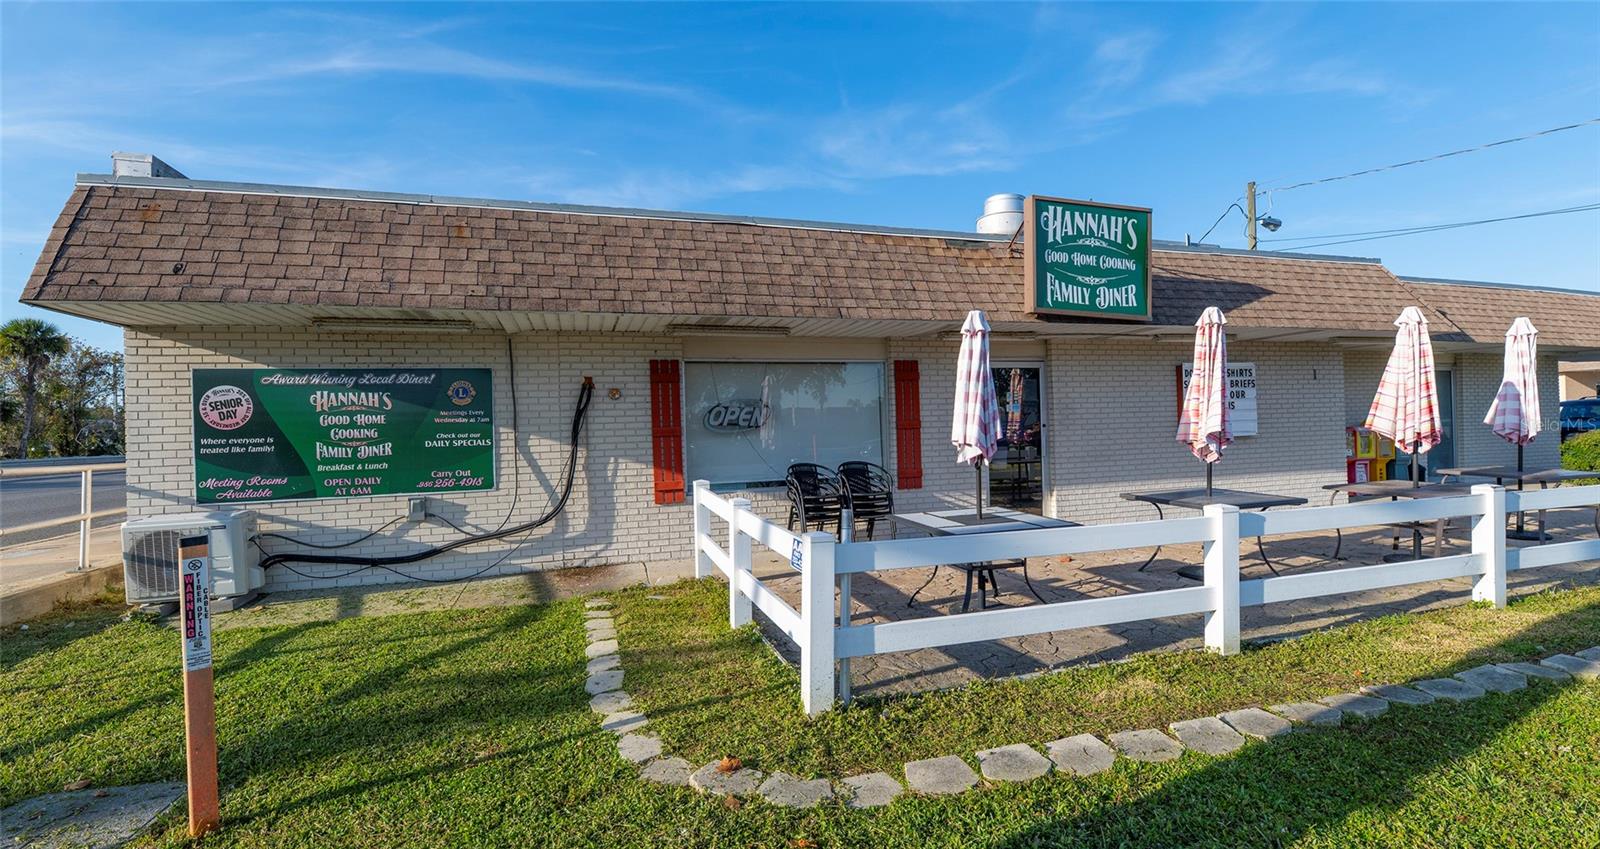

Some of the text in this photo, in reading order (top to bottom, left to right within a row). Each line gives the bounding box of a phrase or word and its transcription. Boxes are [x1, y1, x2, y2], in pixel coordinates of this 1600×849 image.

[1040, 206, 1138, 250] HANNAH'S
[1045, 249, 1136, 271] GOOD HOME COOKING
[1047, 272, 1137, 309] FAMILY DINER
[262, 372, 435, 387] Award Winning Local Diner!
[1227, 369, 1252, 377] SHIRTS
[1230, 380, 1255, 388] BRIEFS
[458, 388, 466, 397] L
[1230, 390, 1246, 399] OUR
[209, 397, 243, 412] SENIOR
[310, 391, 392, 412] HANNAH'S
[218, 409, 237, 421] DAY
[319, 414, 386, 426] GOOD HOME
[710, 406, 762, 427] OPEN
[330, 428, 378, 440] COOKING
[316, 441, 392, 461] FAMILY DINER
[317, 463, 355, 472] Breakfast
[199, 476, 288, 490] Meeting Rooms
[324, 477, 382, 486] OPEN DAILY
[216, 489, 273, 499] Available
[184, 575, 195, 638] WARNING
